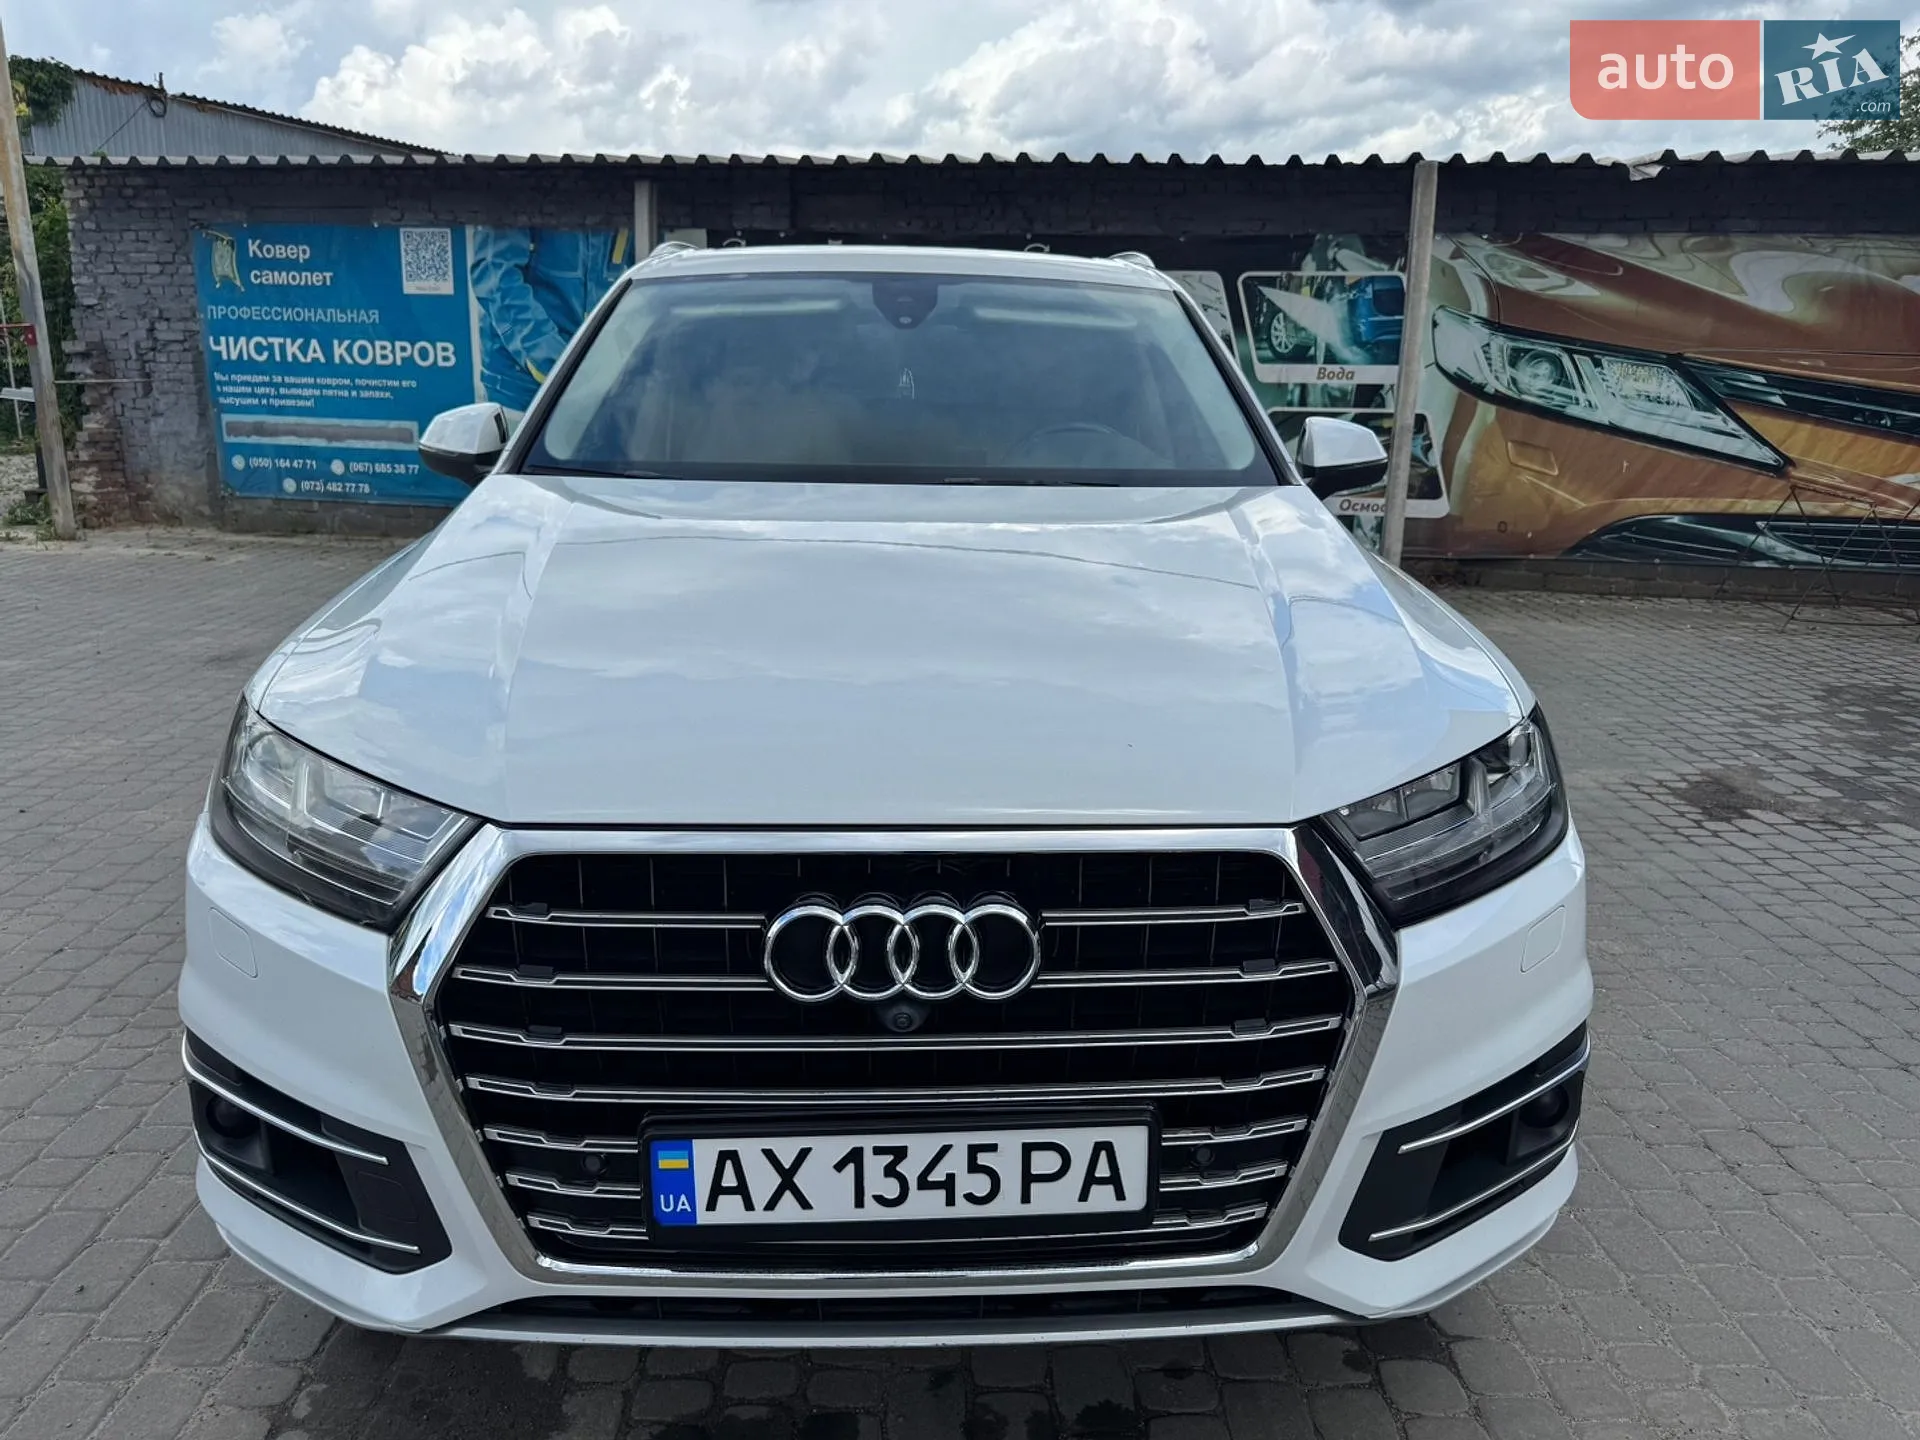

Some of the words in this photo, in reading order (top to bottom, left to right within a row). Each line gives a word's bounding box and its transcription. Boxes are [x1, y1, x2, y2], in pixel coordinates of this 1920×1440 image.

[248, 239, 310, 262] Ковер
[250, 270, 333, 286] самолет
[207, 305, 380, 324] ПРОФЕССИОНАЛЬНАЯ
[209, 335, 326, 364] ЧИСТКА
[333, 339, 457, 367] КОВРОВ
[1316, 366, 1356, 381] Вода
[272, 375, 282, 384] за
[284, 376, 315, 385] вашим
[355, 379, 400, 389] почистим
[401, 380, 417, 389] его
[261, 397, 267, 406] и
[352, 390, 358, 398] и
[292, 459, 303, 469] 47
[306, 459, 317, 470] 71
[349, 461, 373, 475] (067)
[407, 464, 420, 475] 77
[345, 482, 356, 493] 77
[705, 1146, 814, 1212] AX
[832, 1142, 1001, 1209] 1345
[1020, 1139, 1127, 1205] PA
[660, 1194, 691, 1213] UA
